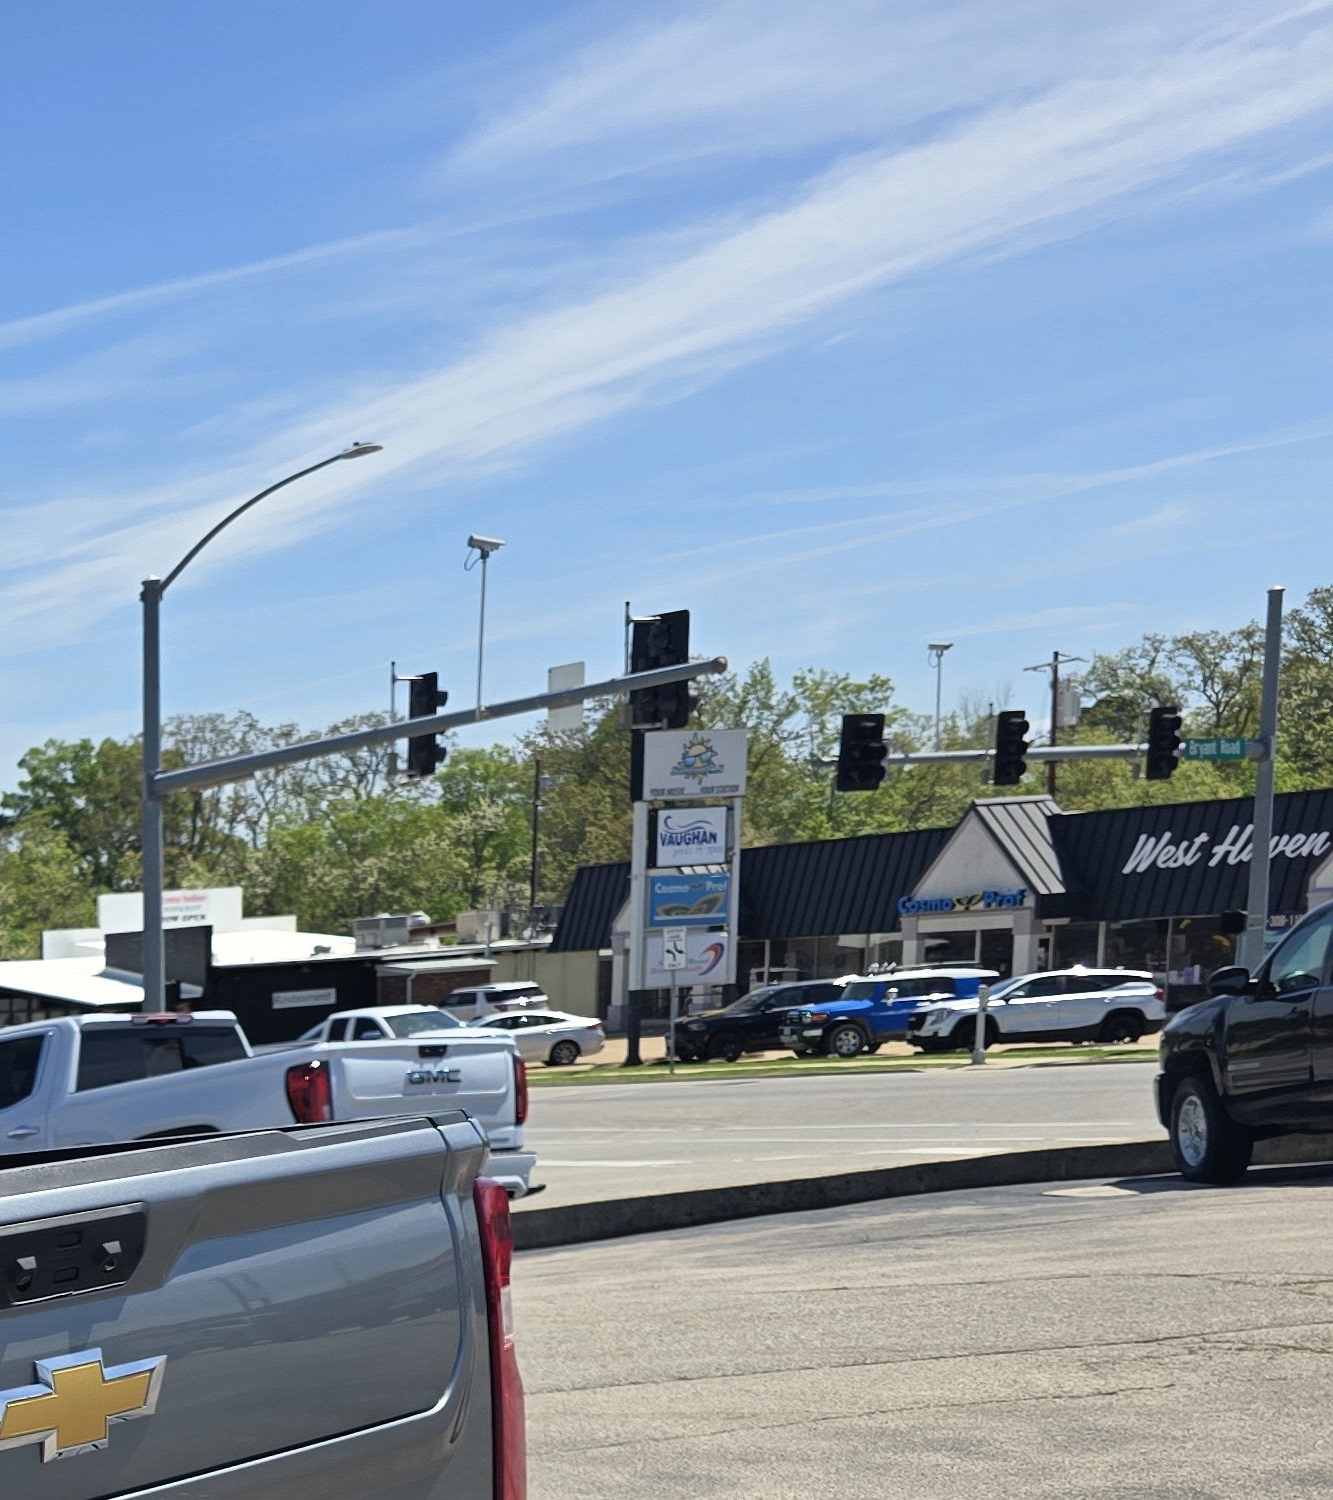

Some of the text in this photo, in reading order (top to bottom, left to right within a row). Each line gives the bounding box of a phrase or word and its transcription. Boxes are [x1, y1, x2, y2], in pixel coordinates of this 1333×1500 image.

[1188, 740, 1240, 758] Bryant Road
[660, 831, 718, 847] VAUGHAN
[1122, 831, 1210, 874] West
[898, 889, 1026, 914] Cosmo Prof
[408, 1069, 461, 1085] GMC
